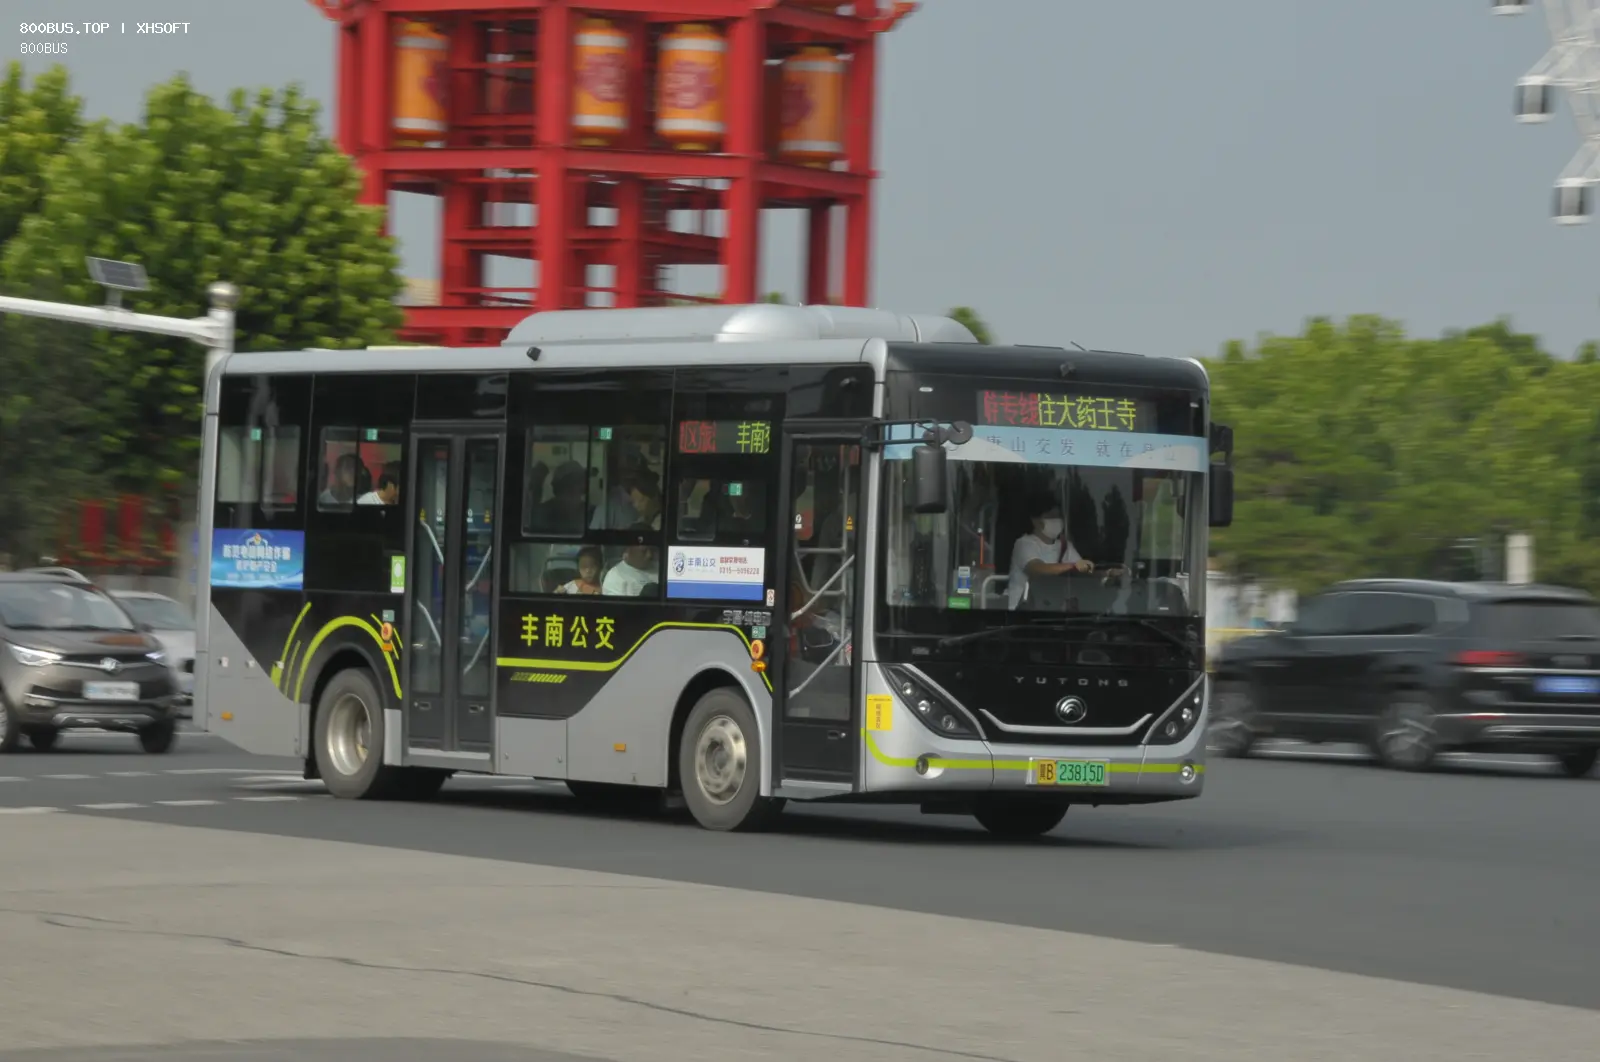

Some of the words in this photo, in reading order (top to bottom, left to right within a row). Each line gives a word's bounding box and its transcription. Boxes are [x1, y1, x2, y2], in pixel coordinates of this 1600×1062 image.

[687, 556, 717, 568] 丰南公交
[520, 613, 615, 650] 丰南公交
